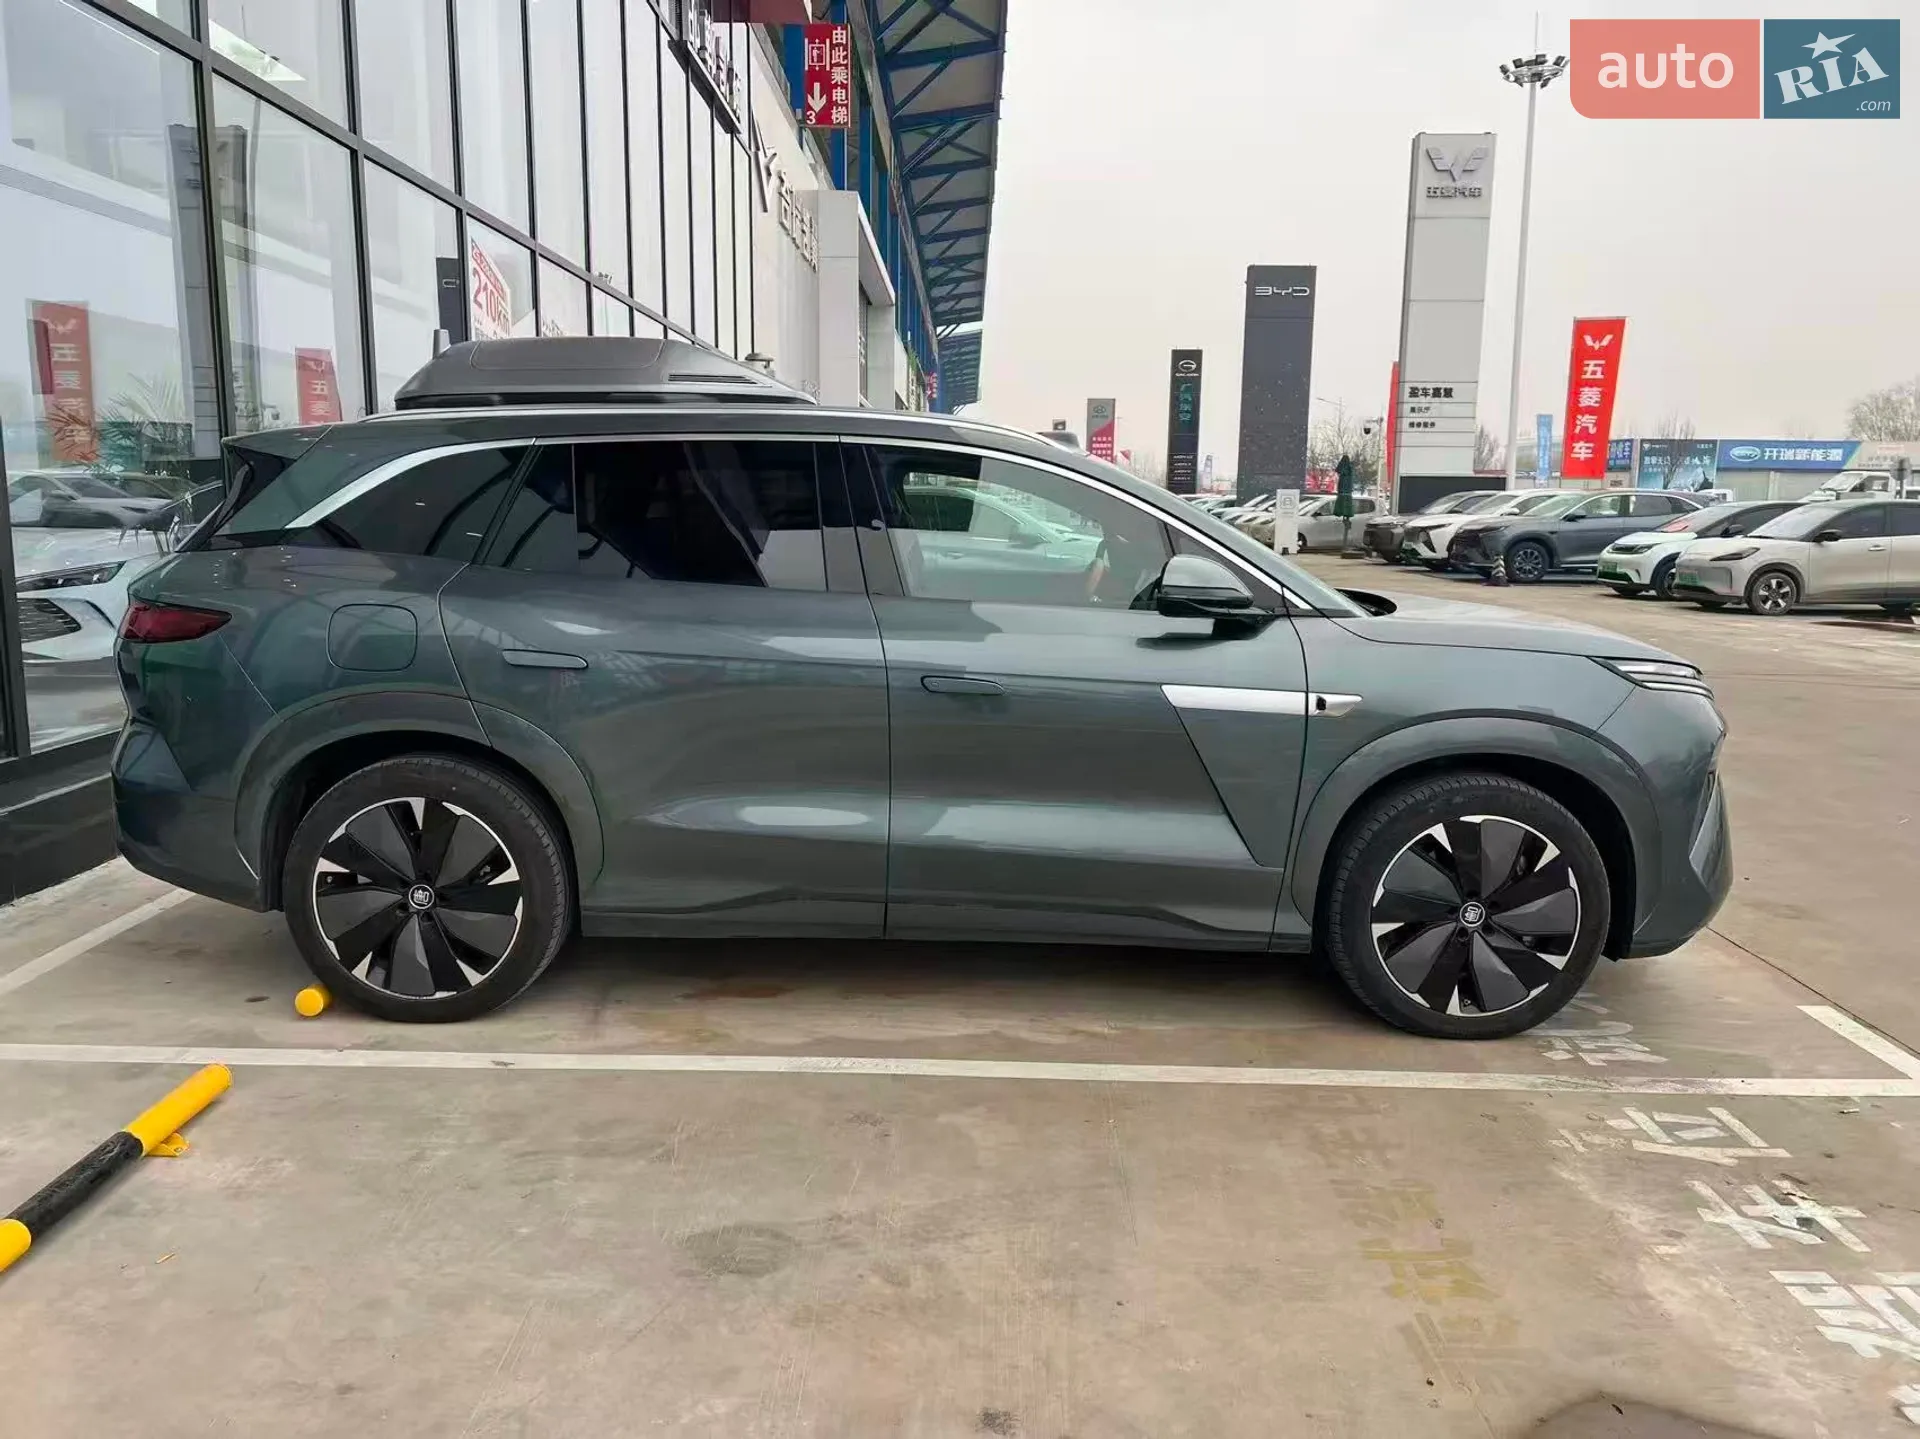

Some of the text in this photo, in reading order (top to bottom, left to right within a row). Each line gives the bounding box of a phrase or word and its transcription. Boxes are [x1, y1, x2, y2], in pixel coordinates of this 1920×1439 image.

[831, 26, 848, 124] 由此乘电梯
[806, 110, 816, 124] 3
[1255, 286, 1310, 296] BYD
[1571, 360, 1606, 461] 五菱汽车
